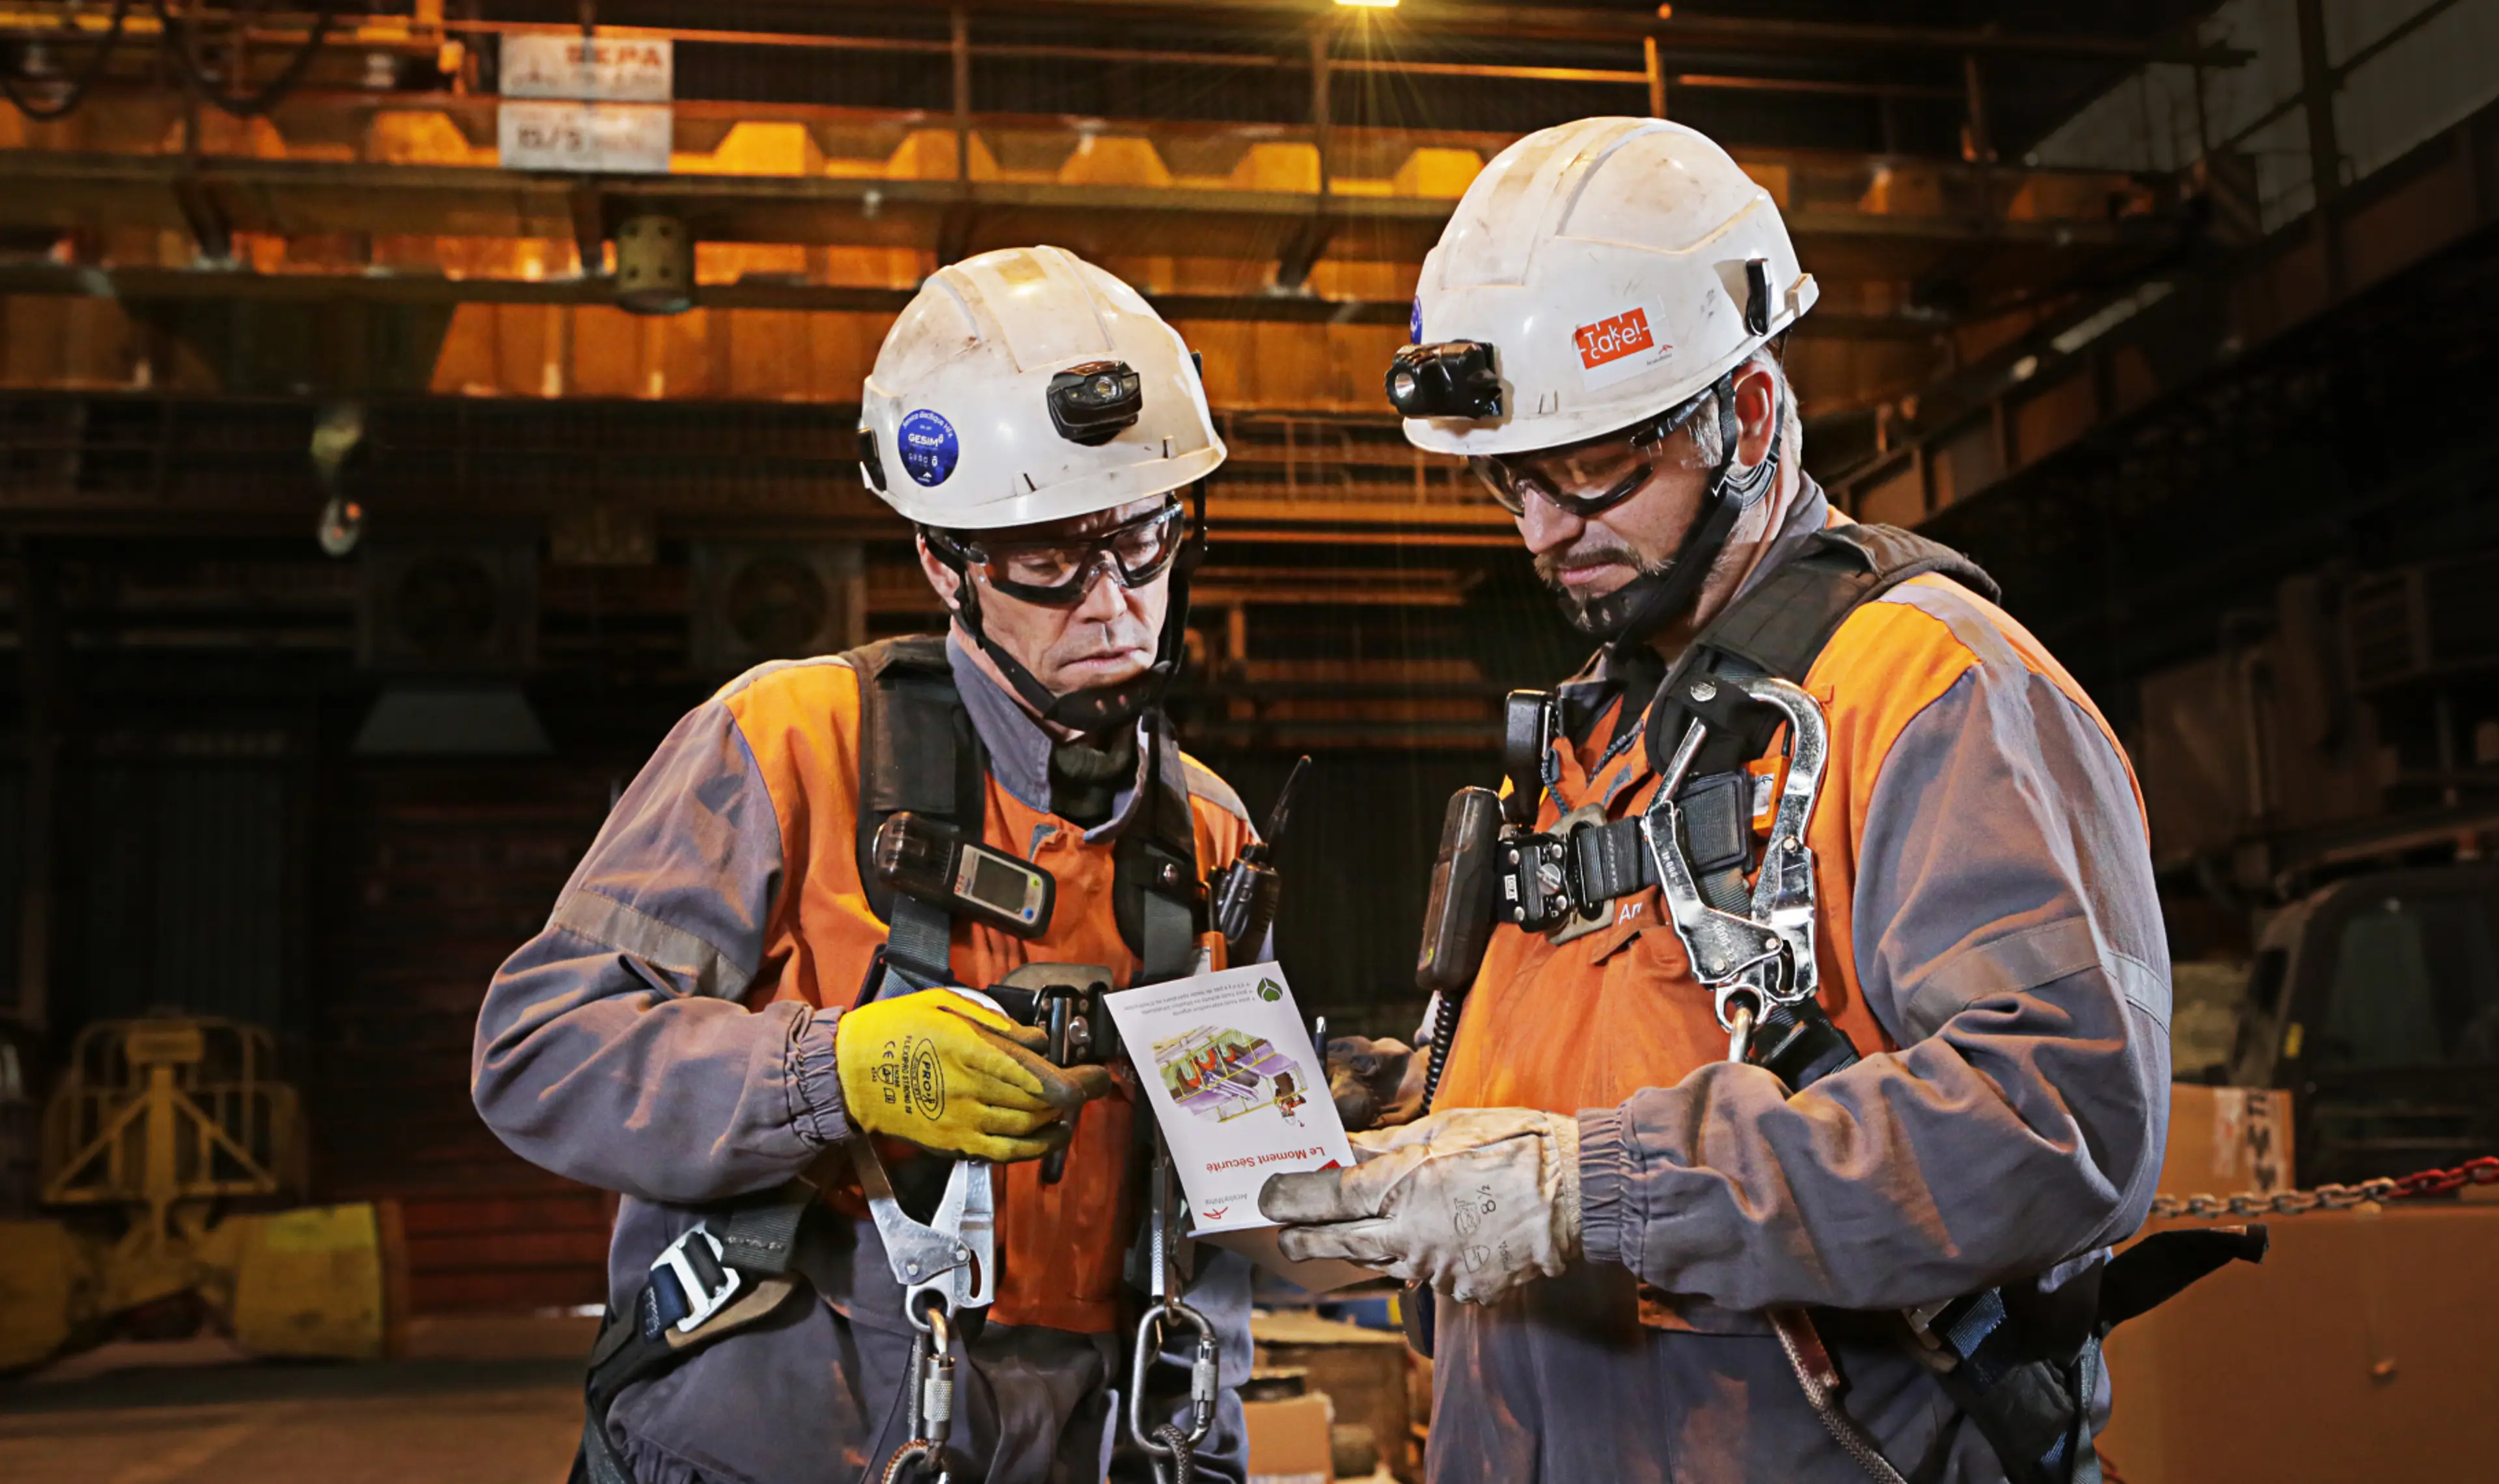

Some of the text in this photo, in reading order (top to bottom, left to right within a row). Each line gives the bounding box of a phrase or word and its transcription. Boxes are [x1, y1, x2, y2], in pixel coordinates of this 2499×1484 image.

[1207, 1146, 1325, 1172] Le Moment Sécurité
